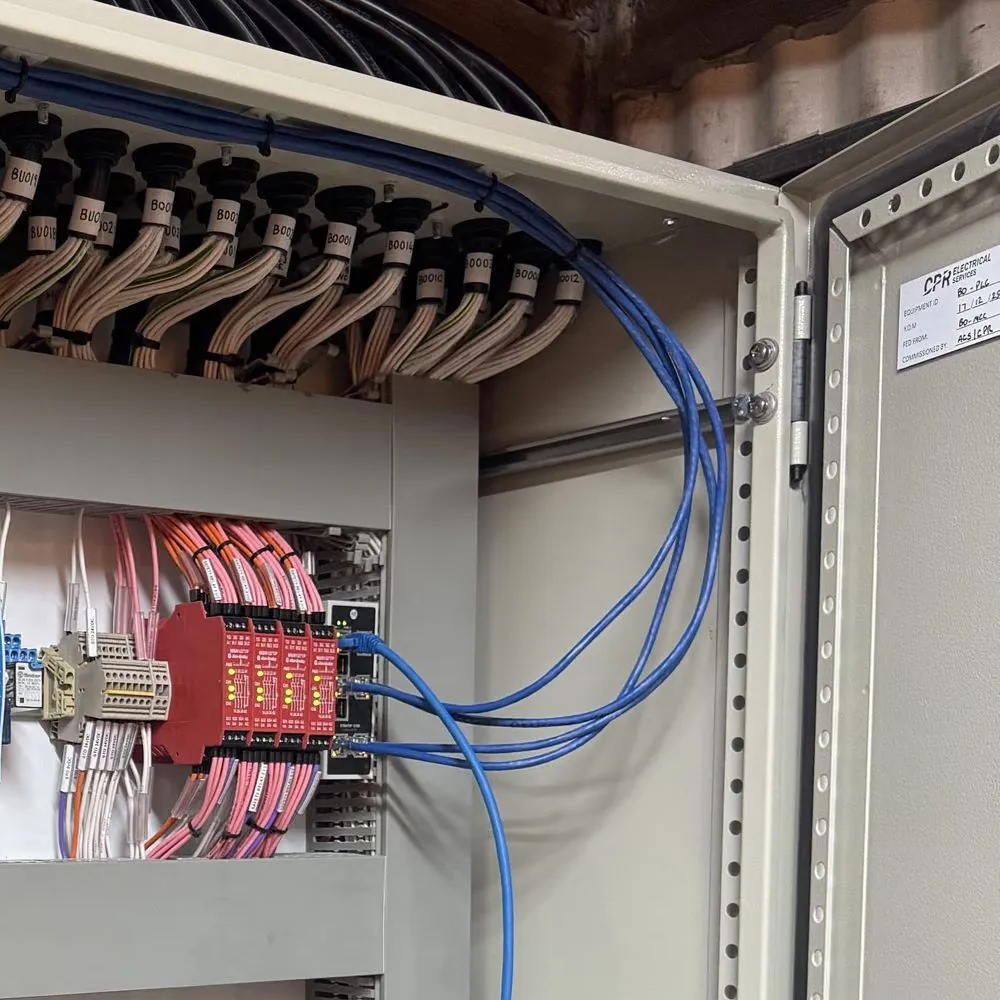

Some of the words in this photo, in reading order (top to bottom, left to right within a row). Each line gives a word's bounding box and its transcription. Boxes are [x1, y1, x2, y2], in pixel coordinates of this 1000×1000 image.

[952, 253, 992, 276] ELECTRICAL
[923, 269, 952, 296] CPR
[952, 268, 977, 284] SERVICES
[903, 300, 933, 317] EQUIPMENT
[902, 340, 912, 348] FED
[902, 344, 940, 364] COMMISSIONED
